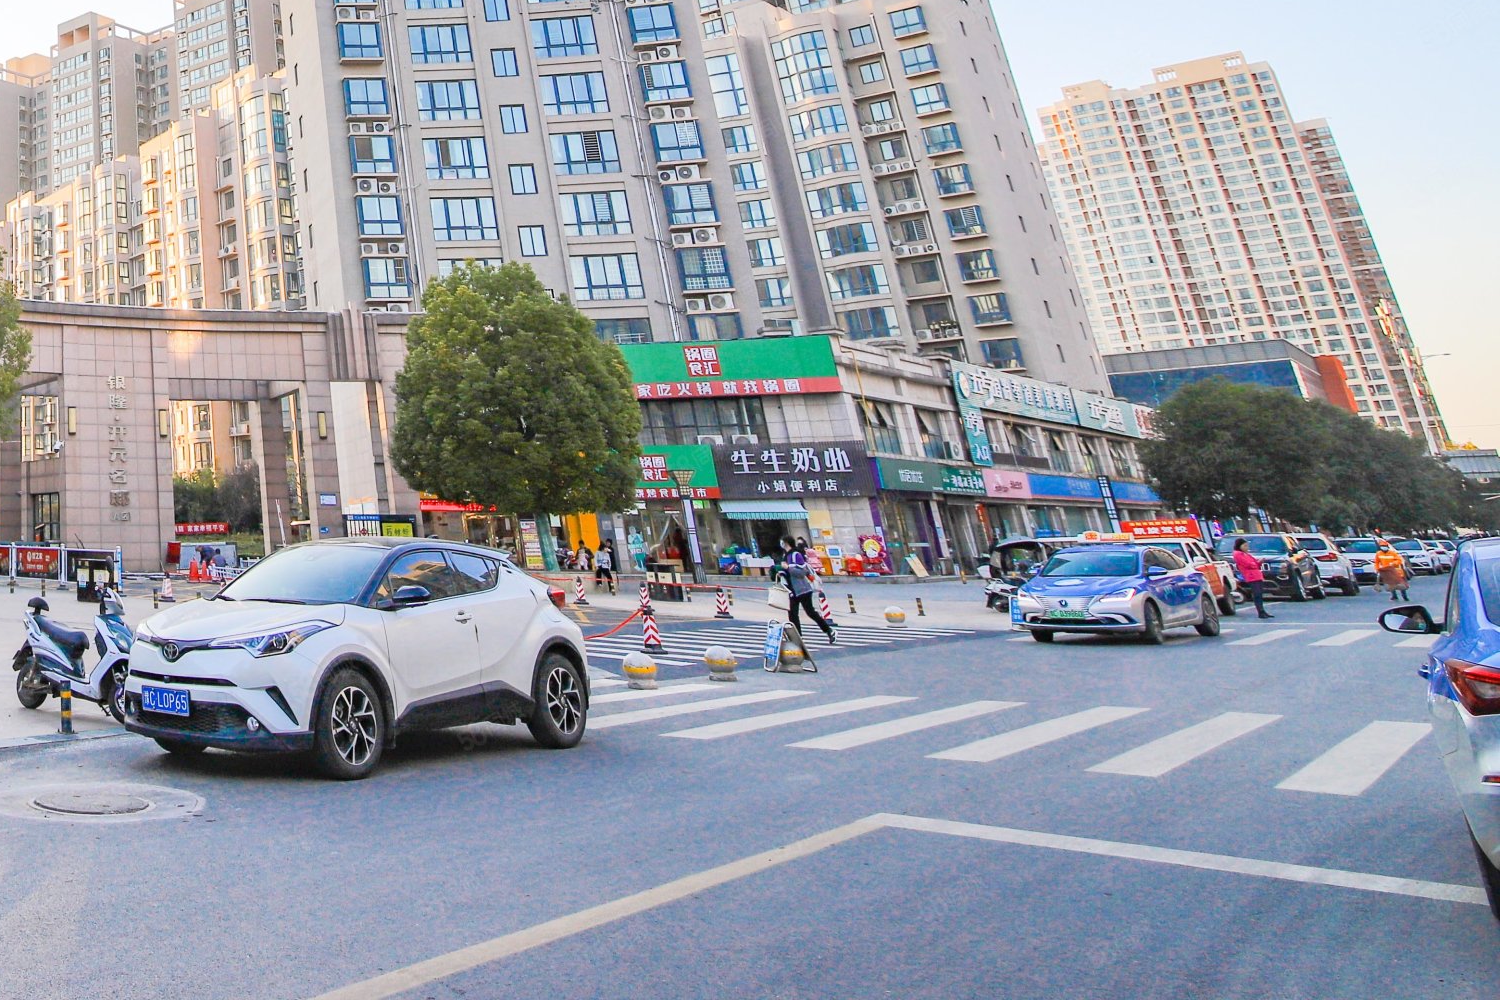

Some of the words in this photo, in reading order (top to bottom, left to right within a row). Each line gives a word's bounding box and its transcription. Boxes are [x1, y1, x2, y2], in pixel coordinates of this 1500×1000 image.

[685, 348, 716, 361] 锅圈
[688, 362, 720, 375] 食汇
[723, 379, 800, 394] 就找锅圈
[639, 456, 665, 468] 锅圈
[731, 447, 852, 475] 生生奶业
[643, 468, 668, 480] 食汇
[757, 478, 839, 494] 小娟便利店
